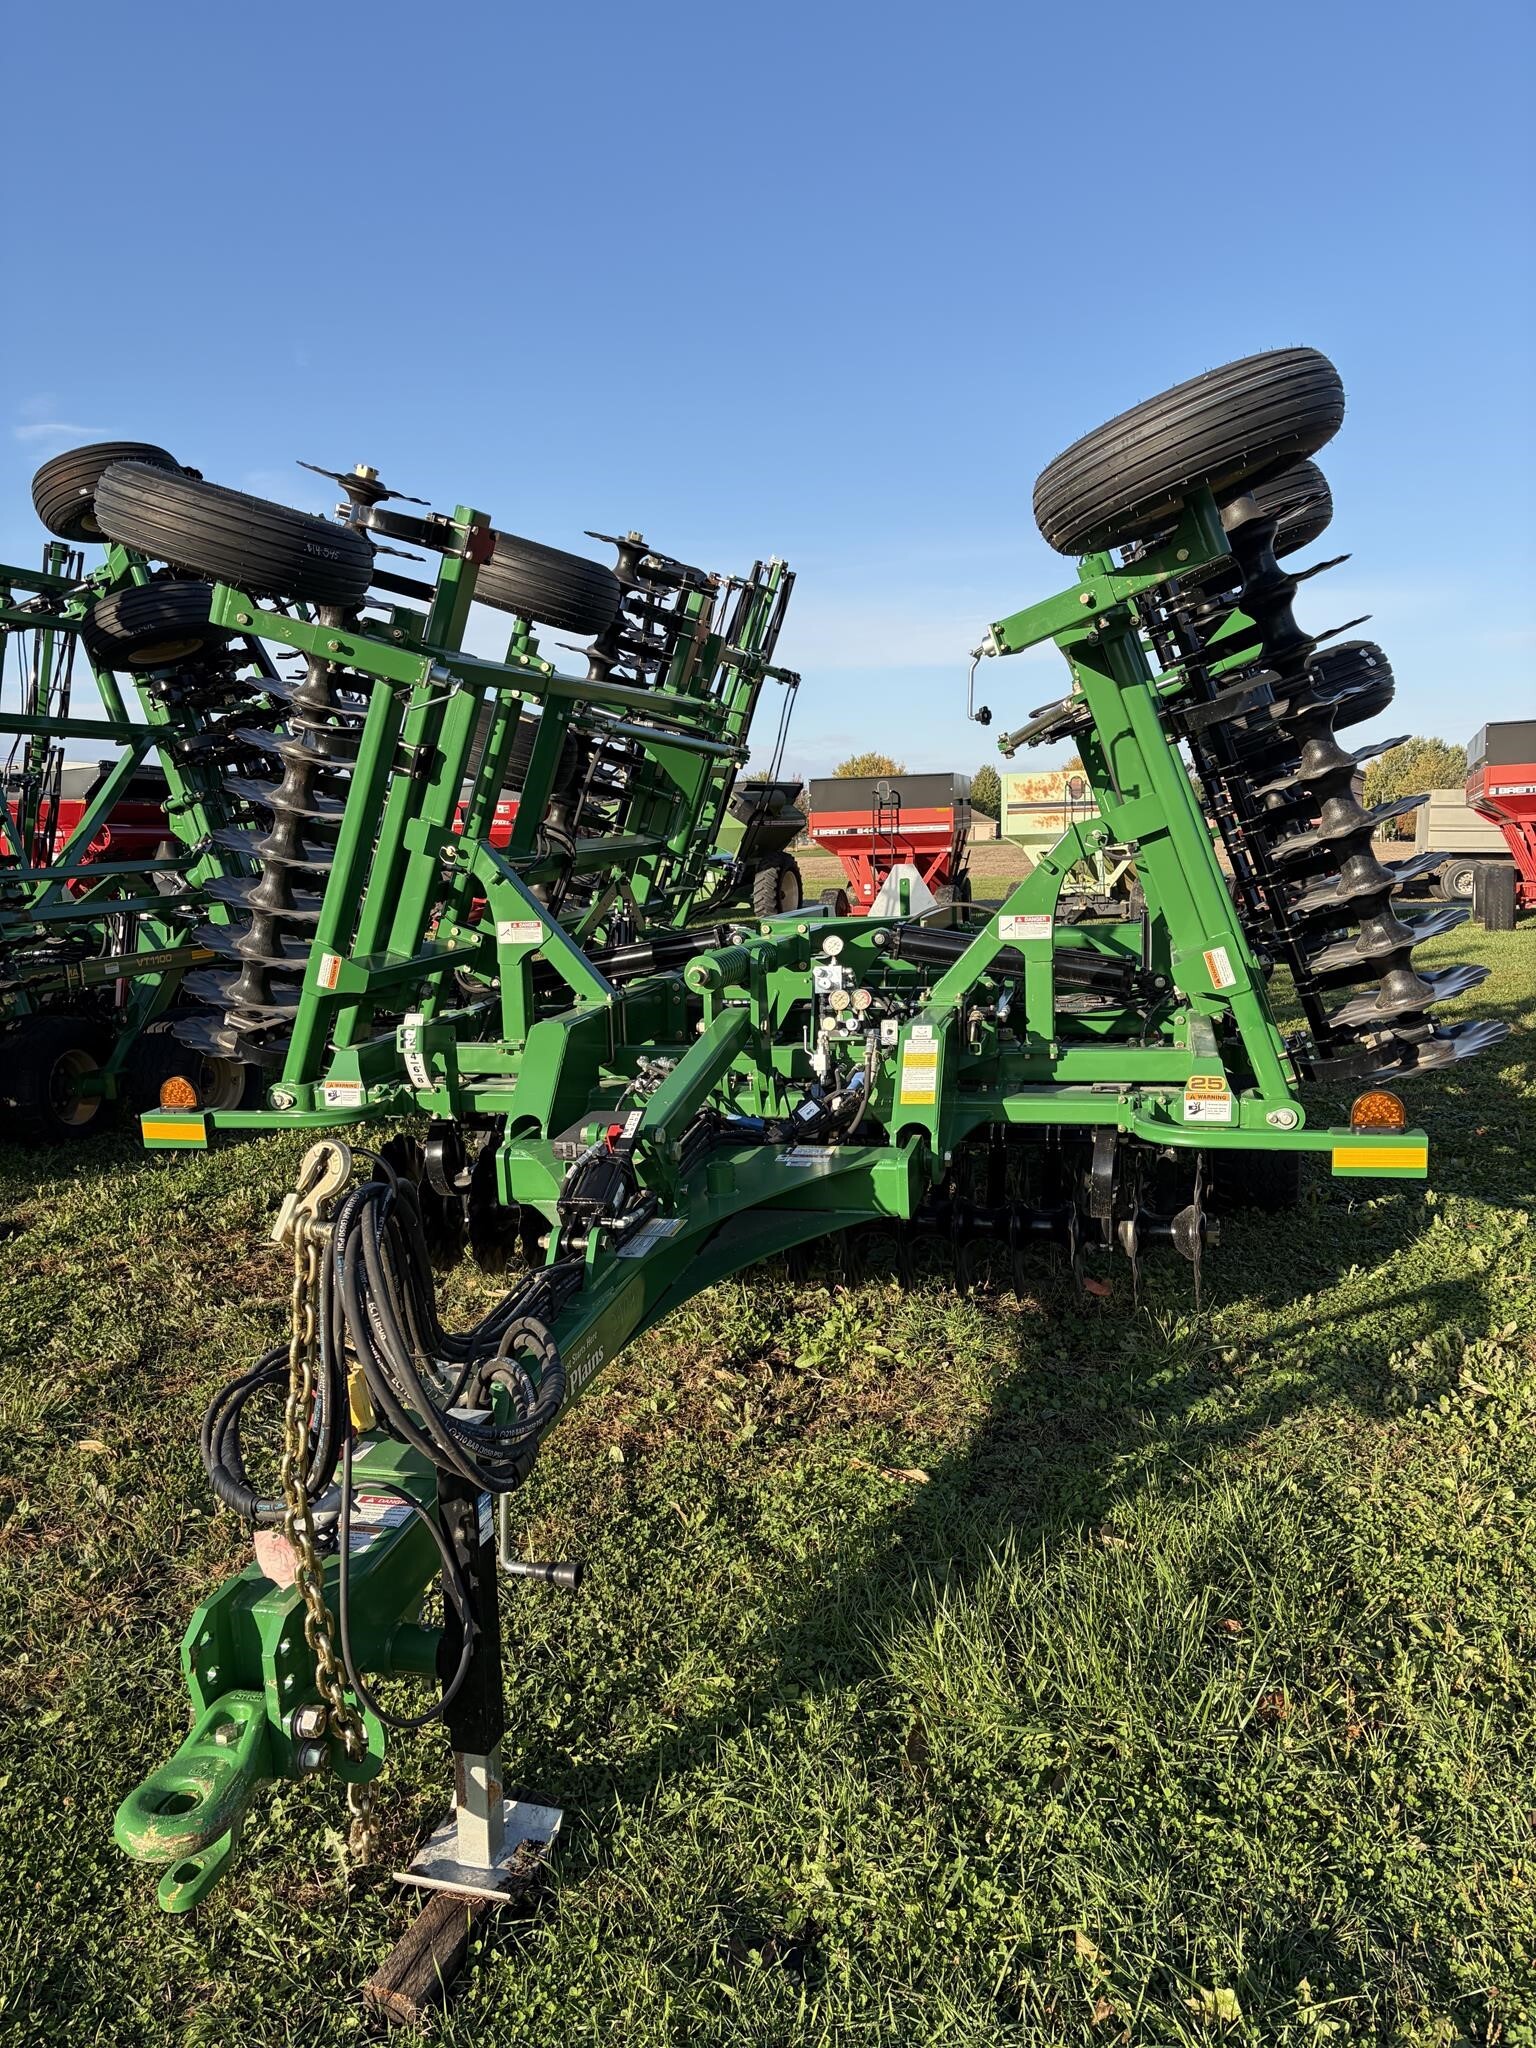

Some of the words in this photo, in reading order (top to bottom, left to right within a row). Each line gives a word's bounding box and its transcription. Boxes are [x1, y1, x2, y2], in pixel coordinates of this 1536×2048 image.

[135, 952, 174, 968] VT1100
[1190, 1076, 1224, 1091] 25
[1197, 1093, 1228, 1101] WARNING
[569, 1344, 604, 1396] Plains
